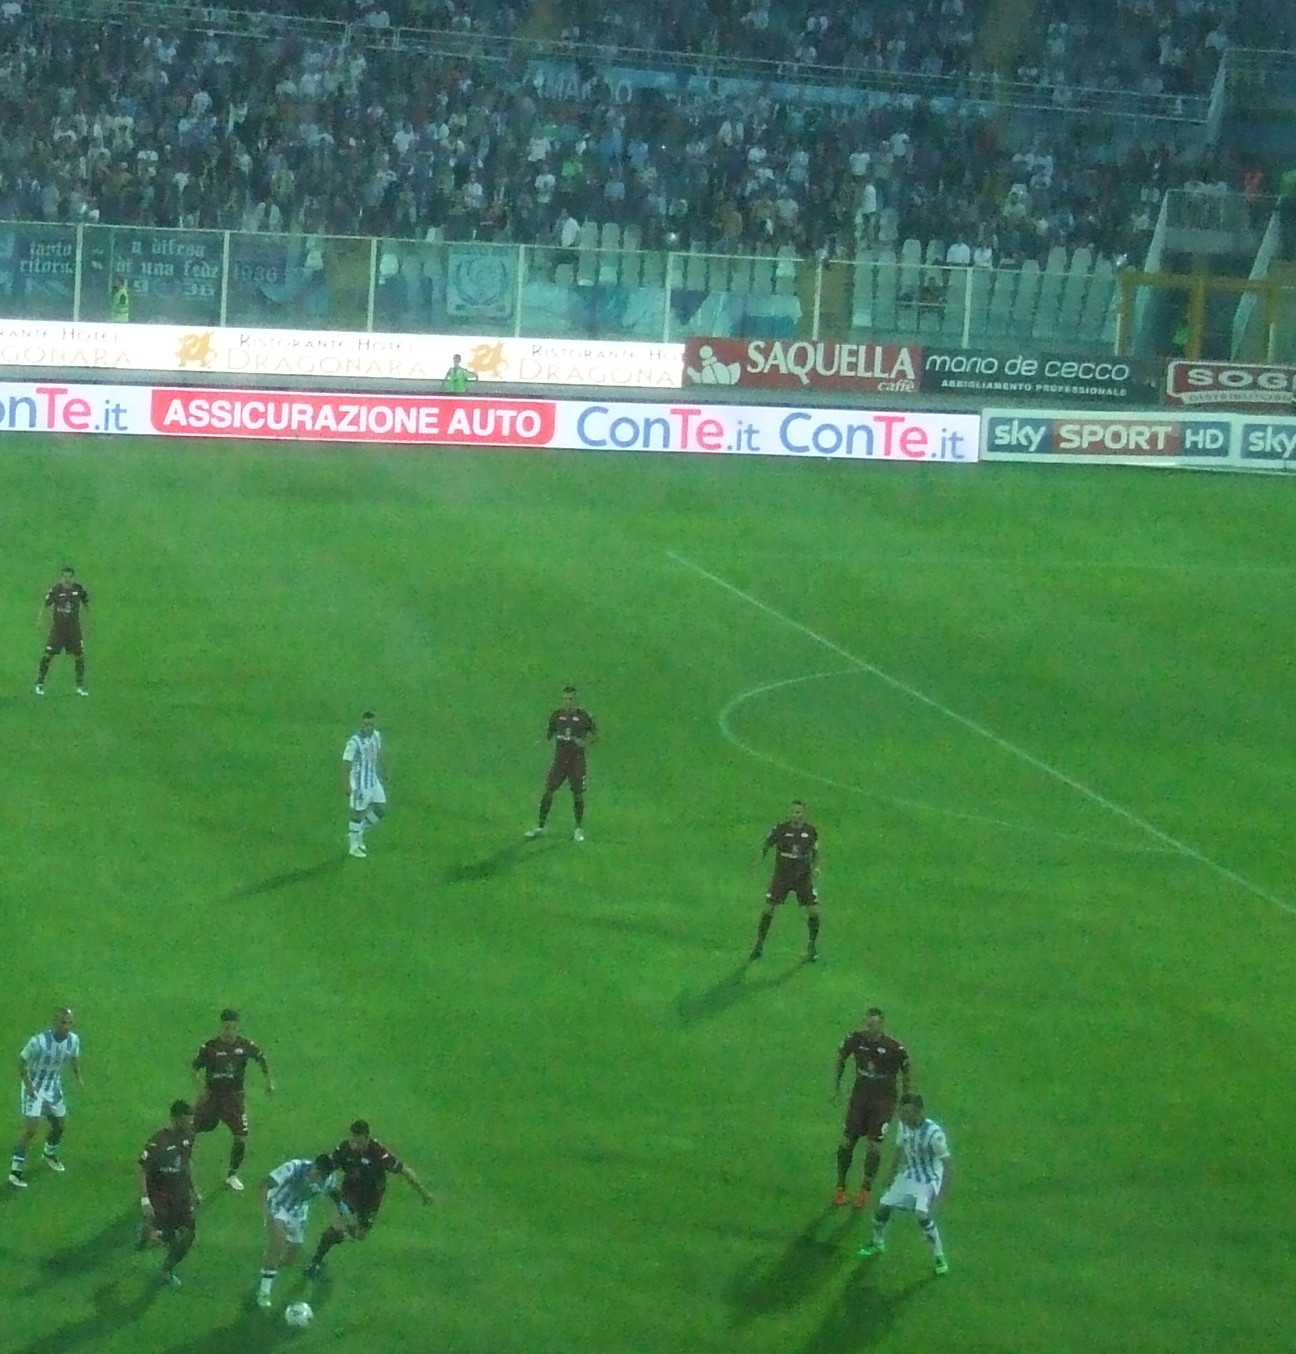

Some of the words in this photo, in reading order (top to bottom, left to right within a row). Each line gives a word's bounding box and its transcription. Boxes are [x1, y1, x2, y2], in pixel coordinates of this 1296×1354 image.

[234, 262, 279, 284] 1936
[228, 349, 427, 376] DRAGONARA
[746, 341, 916, 384] SAQUELLA
[1005, 355, 1037, 376] de
[1044, 360, 1130, 381] cecco
[940, 379, 1032, 391] ABBIGLIAMENTO
[1035, 383, 1128, 397] PROFESSIONALE
[1188, 368, 1296, 393] SOG
[163, 399, 440, 435] ASSICURAZIONE
[448, 407, 541, 437] AUTO
[577, 406, 761, 451] ConTe.it
[779, 411, 965, 459] ConTe.it
[993, 420, 1045, 451] sky
[1059, 424, 1173, 451] SPORT
[1185, 428, 1225, 450] HD
